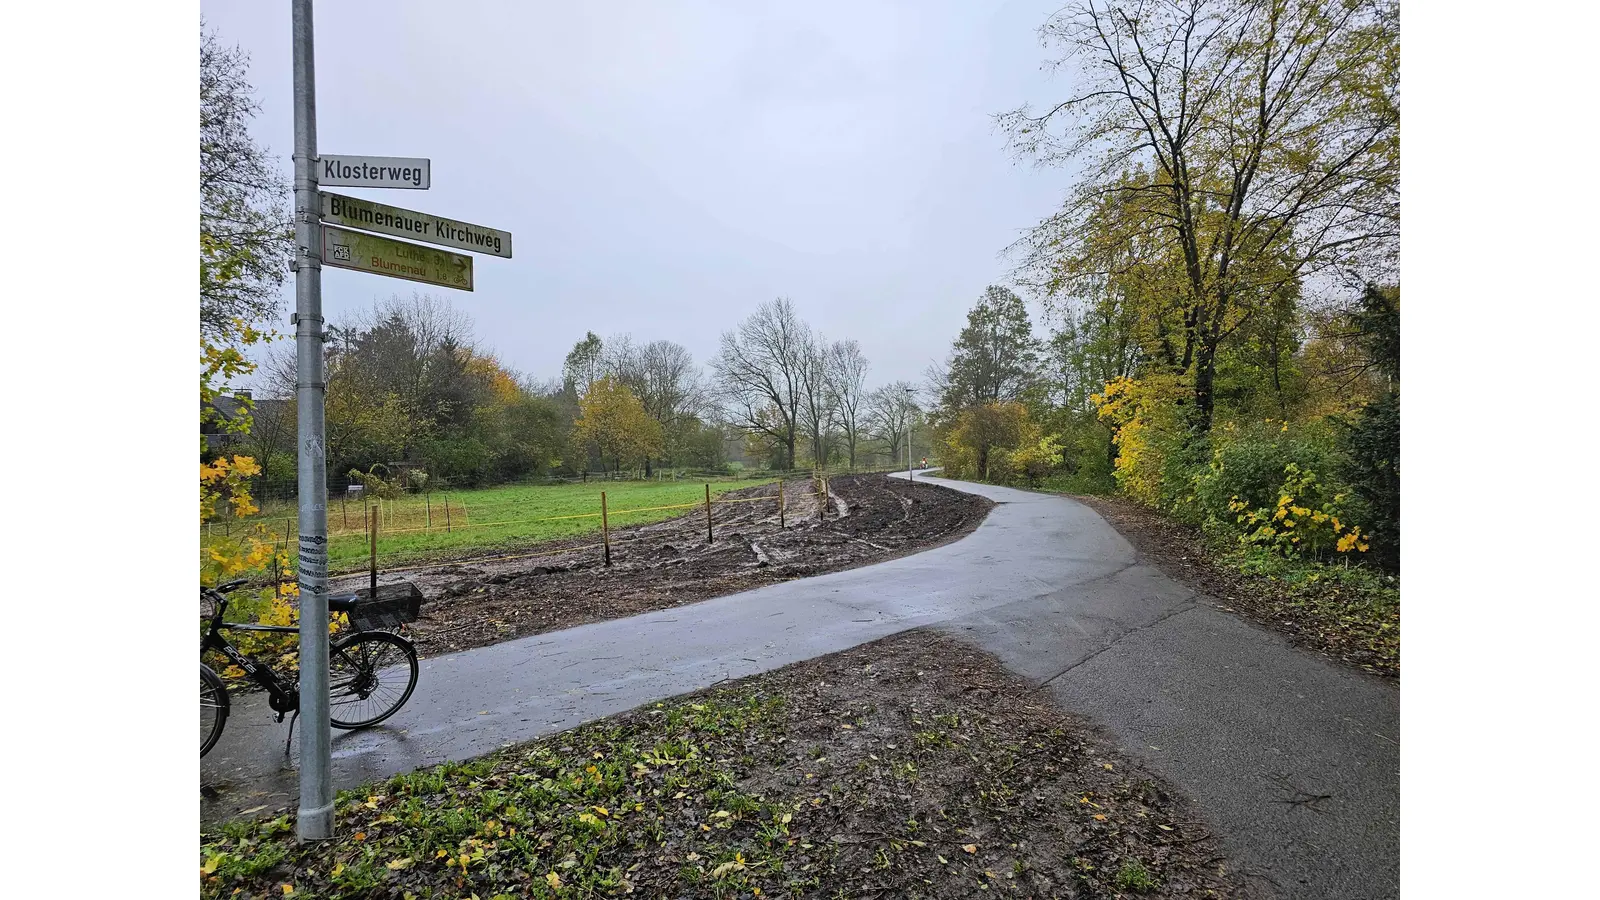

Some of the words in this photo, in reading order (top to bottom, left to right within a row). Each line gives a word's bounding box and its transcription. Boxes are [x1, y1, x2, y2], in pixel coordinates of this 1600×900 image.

[324, 160, 422, 186] Klosterweg
[330, 197, 430, 234] Blumenauer
[436, 220, 501, 253] Kirchweg
[371, 256, 426, 277] Blumenau
